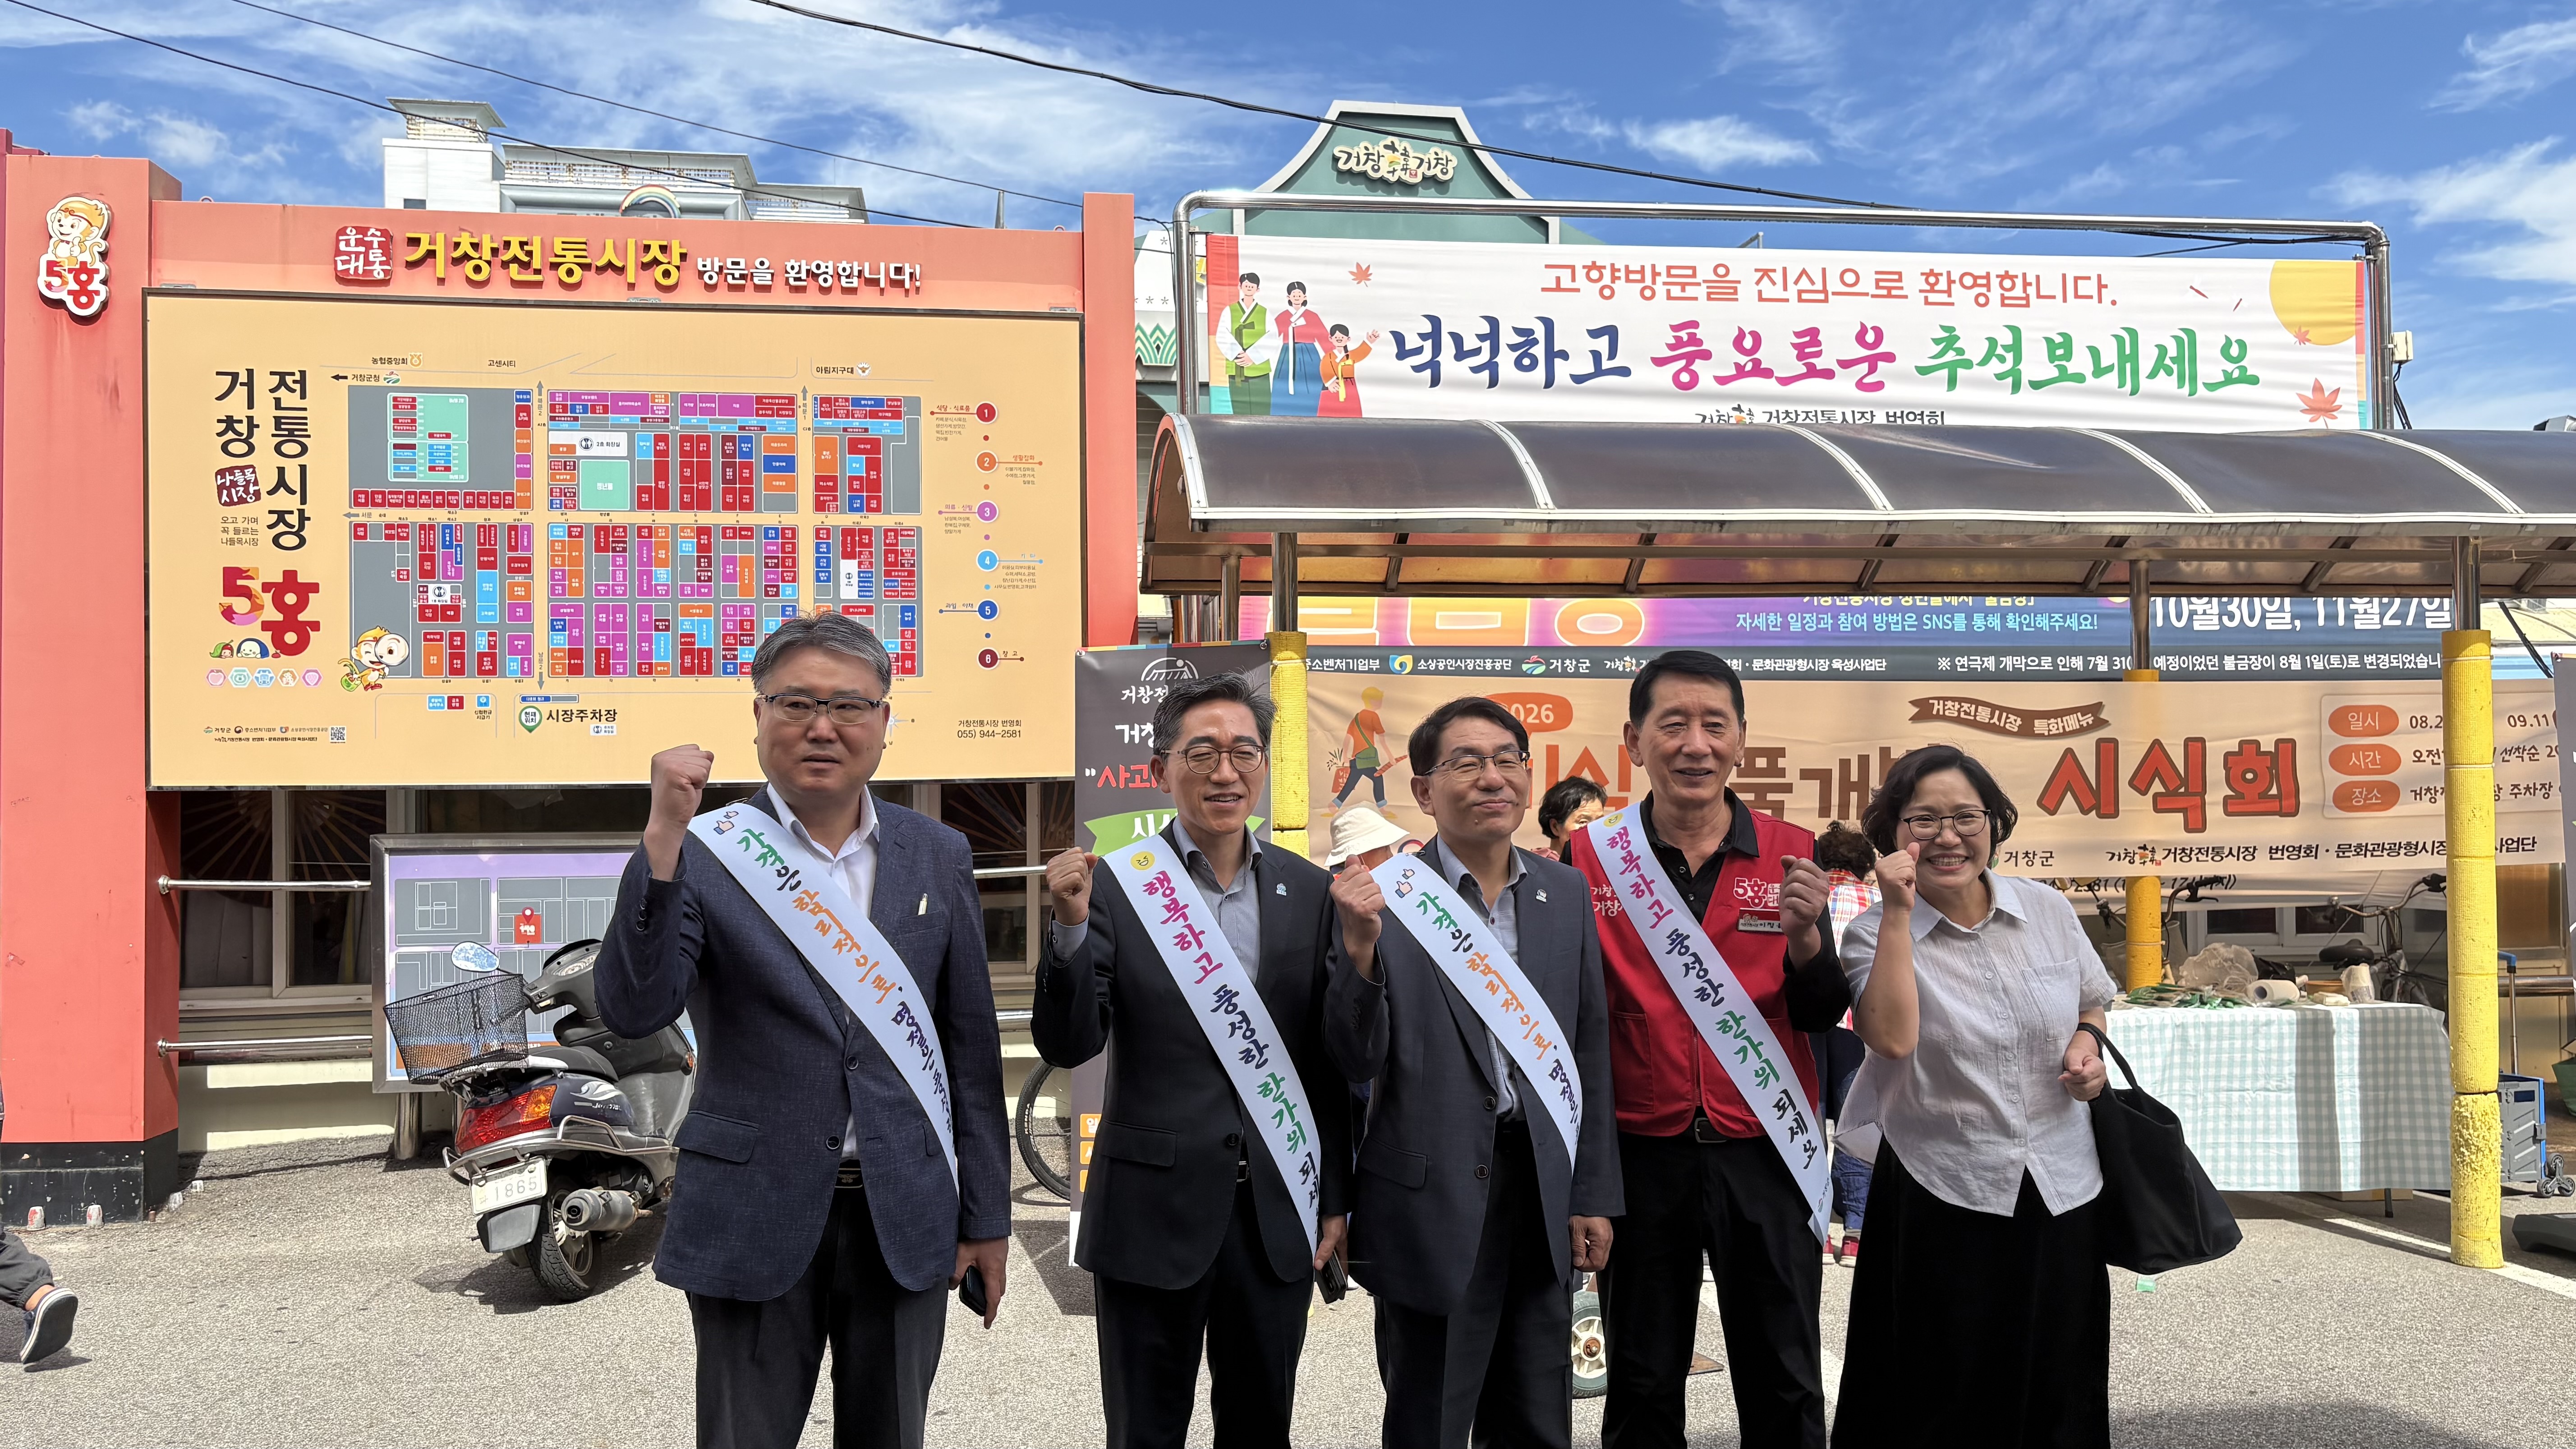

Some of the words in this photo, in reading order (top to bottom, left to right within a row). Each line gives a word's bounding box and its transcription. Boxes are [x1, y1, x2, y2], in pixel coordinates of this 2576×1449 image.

[338, 227, 387, 253] 운수
[336, 248, 391, 279] 대통
[404, 230, 688, 288] 거창전통시장
[697, 256, 773, 286] 방문을
[784, 257, 922, 290] 환영합니다!
[44, 260, 101, 310] 5홍
[1541, 260, 1742, 304] 고향방문을
[1753, 265, 1909, 304] 진심으로
[1918, 266, 2118, 308] 환영합니다.
[371, 357, 408, 365] 농협중앙회
[1389, 314, 1632, 391] 넉넉하고
[1650, 319, 1897, 393] 풍요로운
[1914, 323, 2261, 397] 추석보내세요
[351, 373, 381, 382] 거창군청
[815, 366, 855, 375] 아림지구대
[984, 409, 988, 418] 1
[214, 370, 260, 459] 거창
[266, 369, 312, 552] 전통시장
[984, 458, 989, 467] 2
[216, 468, 257, 486] 나들목
[221, 483, 260, 503] 시장
[220, 516, 239, 524] 오고
[242, 516, 259, 525] 가며
[984, 508, 990, 517] 3
[220, 527, 230, 535] 꼭
[232, 527, 259, 535] 들르는
[220, 537, 259, 547] 나들목시장
[985, 556, 990, 565] 4
[218, 566, 321, 656] 5홍
[985, 606, 991, 616] 5
[1736, 612, 1782, 632] 자세한
[1787, 612, 1833, 632] 일정과
[1837, 612, 1868, 632] 참여
[1872, 612, 1918, 632] 방법은
[1922, 612, 1967, 632] SNS를
[1971, 612, 2001, 632] 통해
[2006, 612, 2098, 632] 확인해주세요!
[985, 654, 991, 664] 6
[1417, 657, 1512, 672] 소상공인시장진흥공단
[1549, 658, 1591, 673] 거창군
[1751, 659, 1830, 672] 문화관광형시장
[1831, 658, 1886, 671] 육성사업단
[1955, 656, 1996, 672] 연극제
[1999, 656, 2053, 672] 개막으로
[2057, 656, 2084, 672] 인해
[2086, 656, 2109, 671] 7월
[2153, 655, 2219, 672] 예정이었던
[2222, 654, 2277, 672] 불금장이
[2279, 654, 2302, 671] 8월
[2305, 653, 2361, 671] 1일(토)로
[2363, 653, 2442, 671] 변경되었습니
[546, 708, 618, 722] 시장주차장
[957, 719, 999, 728] 거창전통시장
[1001, 719, 1022, 727] 번영회
[1509, 703, 1554, 724] 026
[1928, 699, 2022, 732] 거창전통시장
[2033, 711, 2095, 737] 특화메뉴
[2347, 712, 2379, 731] 일시
[2409, 715, 2443, 729] 08.2
[957, 729, 977, 739] 055)
[979, 729, 1022, 739] 944-2581
[2349, 750, 2382, 769] 시간
[2500, 745, 2540, 763] 선착순
[2036, 736, 2300, 834] 시식회
[2351, 787, 2382, 806] 장소
[2509, 781, 2553, 800] 주차장
[736, 828, 802, 892] 가격은
[2004, 851, 2055, 868] 거창군
[2162, 845, 2259, 864] 거창전통시장
[2268, 843, 2320, 861] 번영회
[1415, 891, 1474, 953] 가격은
[1606, 825, 1674, 929] 행복하고
[1665, 927, 1725, 1007] 풍성한
[1715, 1010, 1781, 1090] 한가위
[1771, 1088, 1818, 1170] 되세요
[1142, 870, 1224, 984] 행복하고
[1210, 983, 1270, 1070] 풍성한
[1256, 1072, 1307, 1155] 한가위
[495, 1175, 538, 1201] 1865
